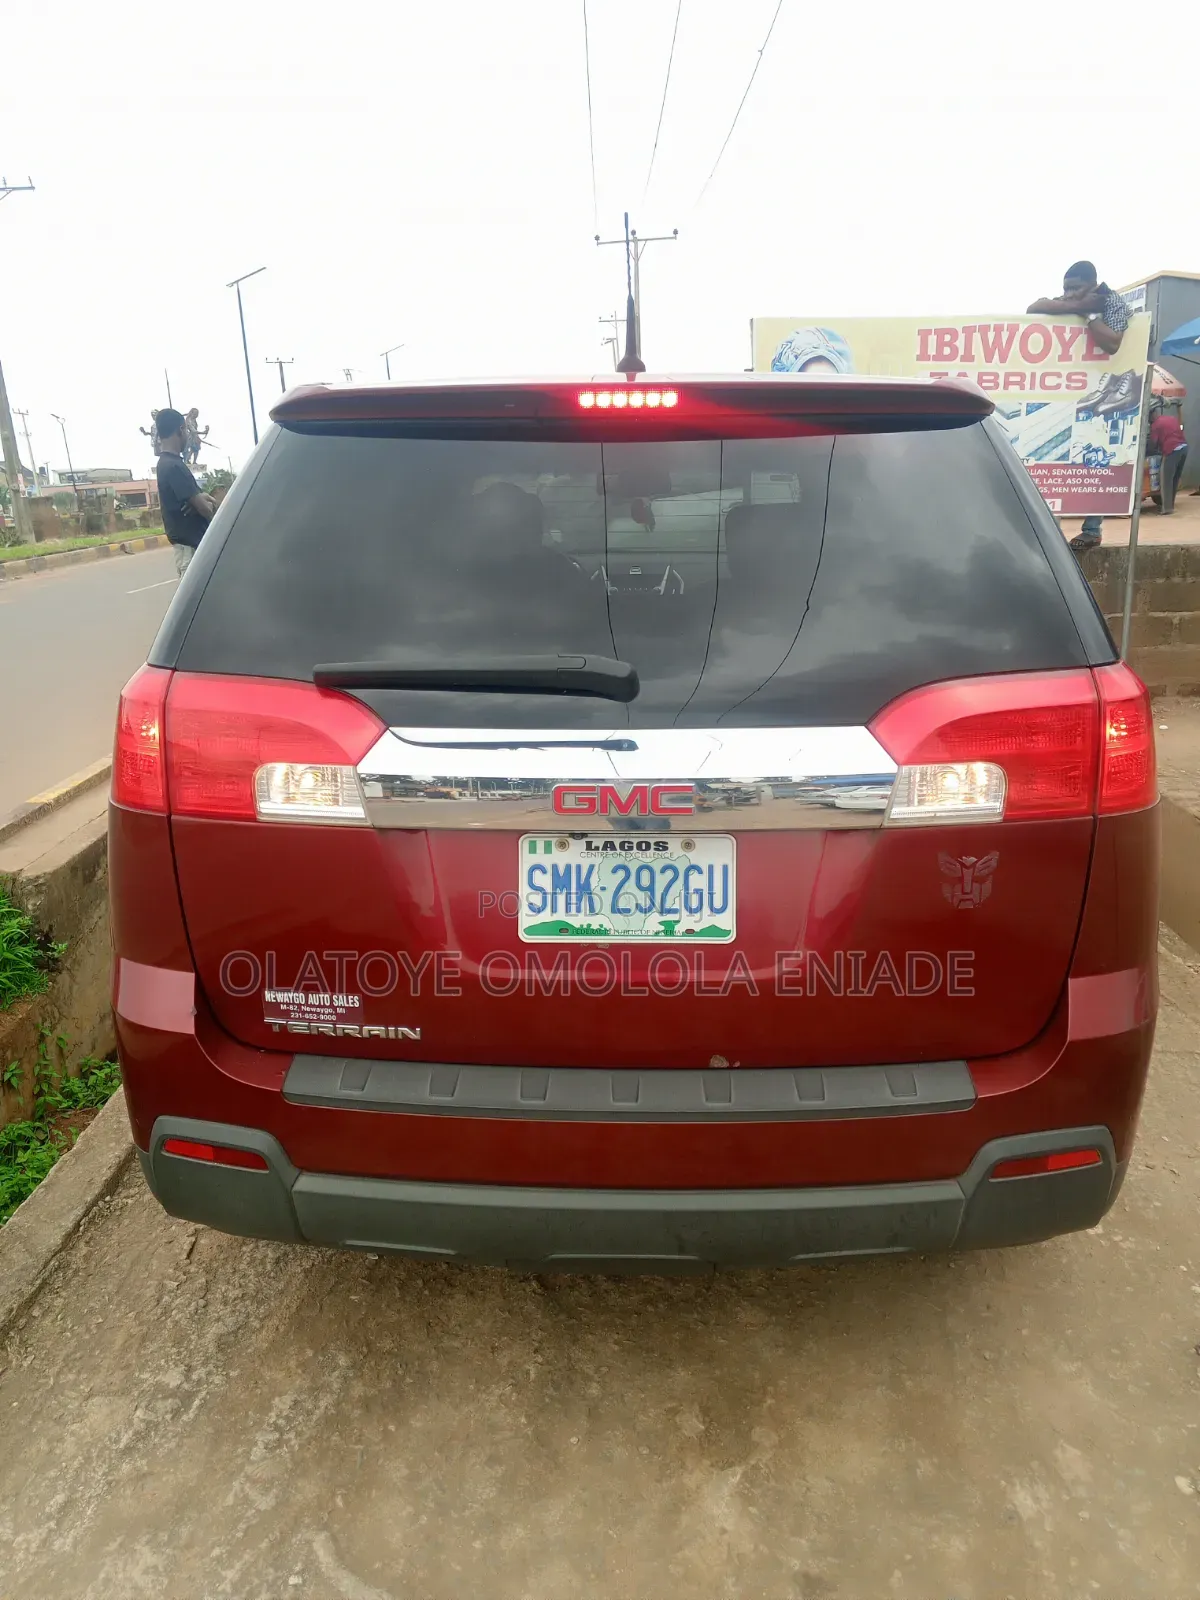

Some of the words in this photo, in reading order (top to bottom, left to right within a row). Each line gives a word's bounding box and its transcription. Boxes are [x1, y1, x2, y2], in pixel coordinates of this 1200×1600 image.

[929, 371, 1088, 391] BRICS
[553, 784, 695, 816] GMC
[580, 851, 610, 859] CENTRE
[611, 851, 623, 859] OF
[624, 851, 674, 859] EXCELLENCE
[585, 840, 669, 852] LAGOS
[264, 990, 305, 1005] NEWAYGO
[308, 993, 331, 1006] AUTO
[332, 995, 360, 1008] SALES
[280, 1004, 300, 1012] M-82,
[301, 1005, 335, 1014] Newaygo,
[264, 1019, 421, 1040] TERRAIN
